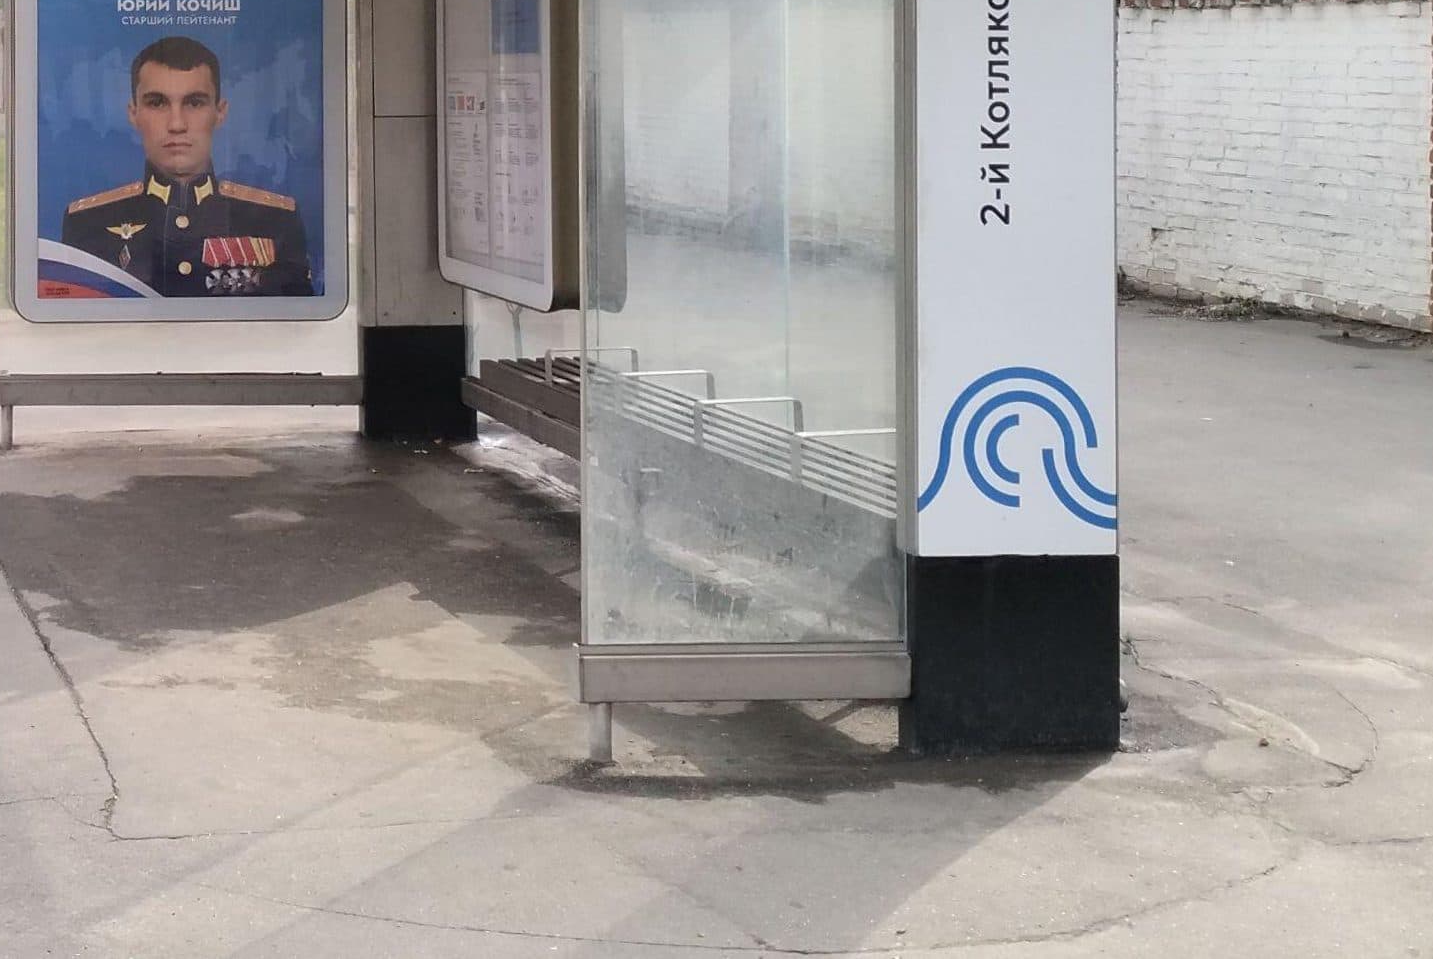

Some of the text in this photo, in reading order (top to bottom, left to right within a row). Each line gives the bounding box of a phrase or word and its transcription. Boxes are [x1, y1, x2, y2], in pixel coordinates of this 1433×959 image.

[177, 0, 241, 12] КОЧИШ
[121, 15, 172, 25] СТАРШИЙ
[979, 164, 1010, 226] 2-й
